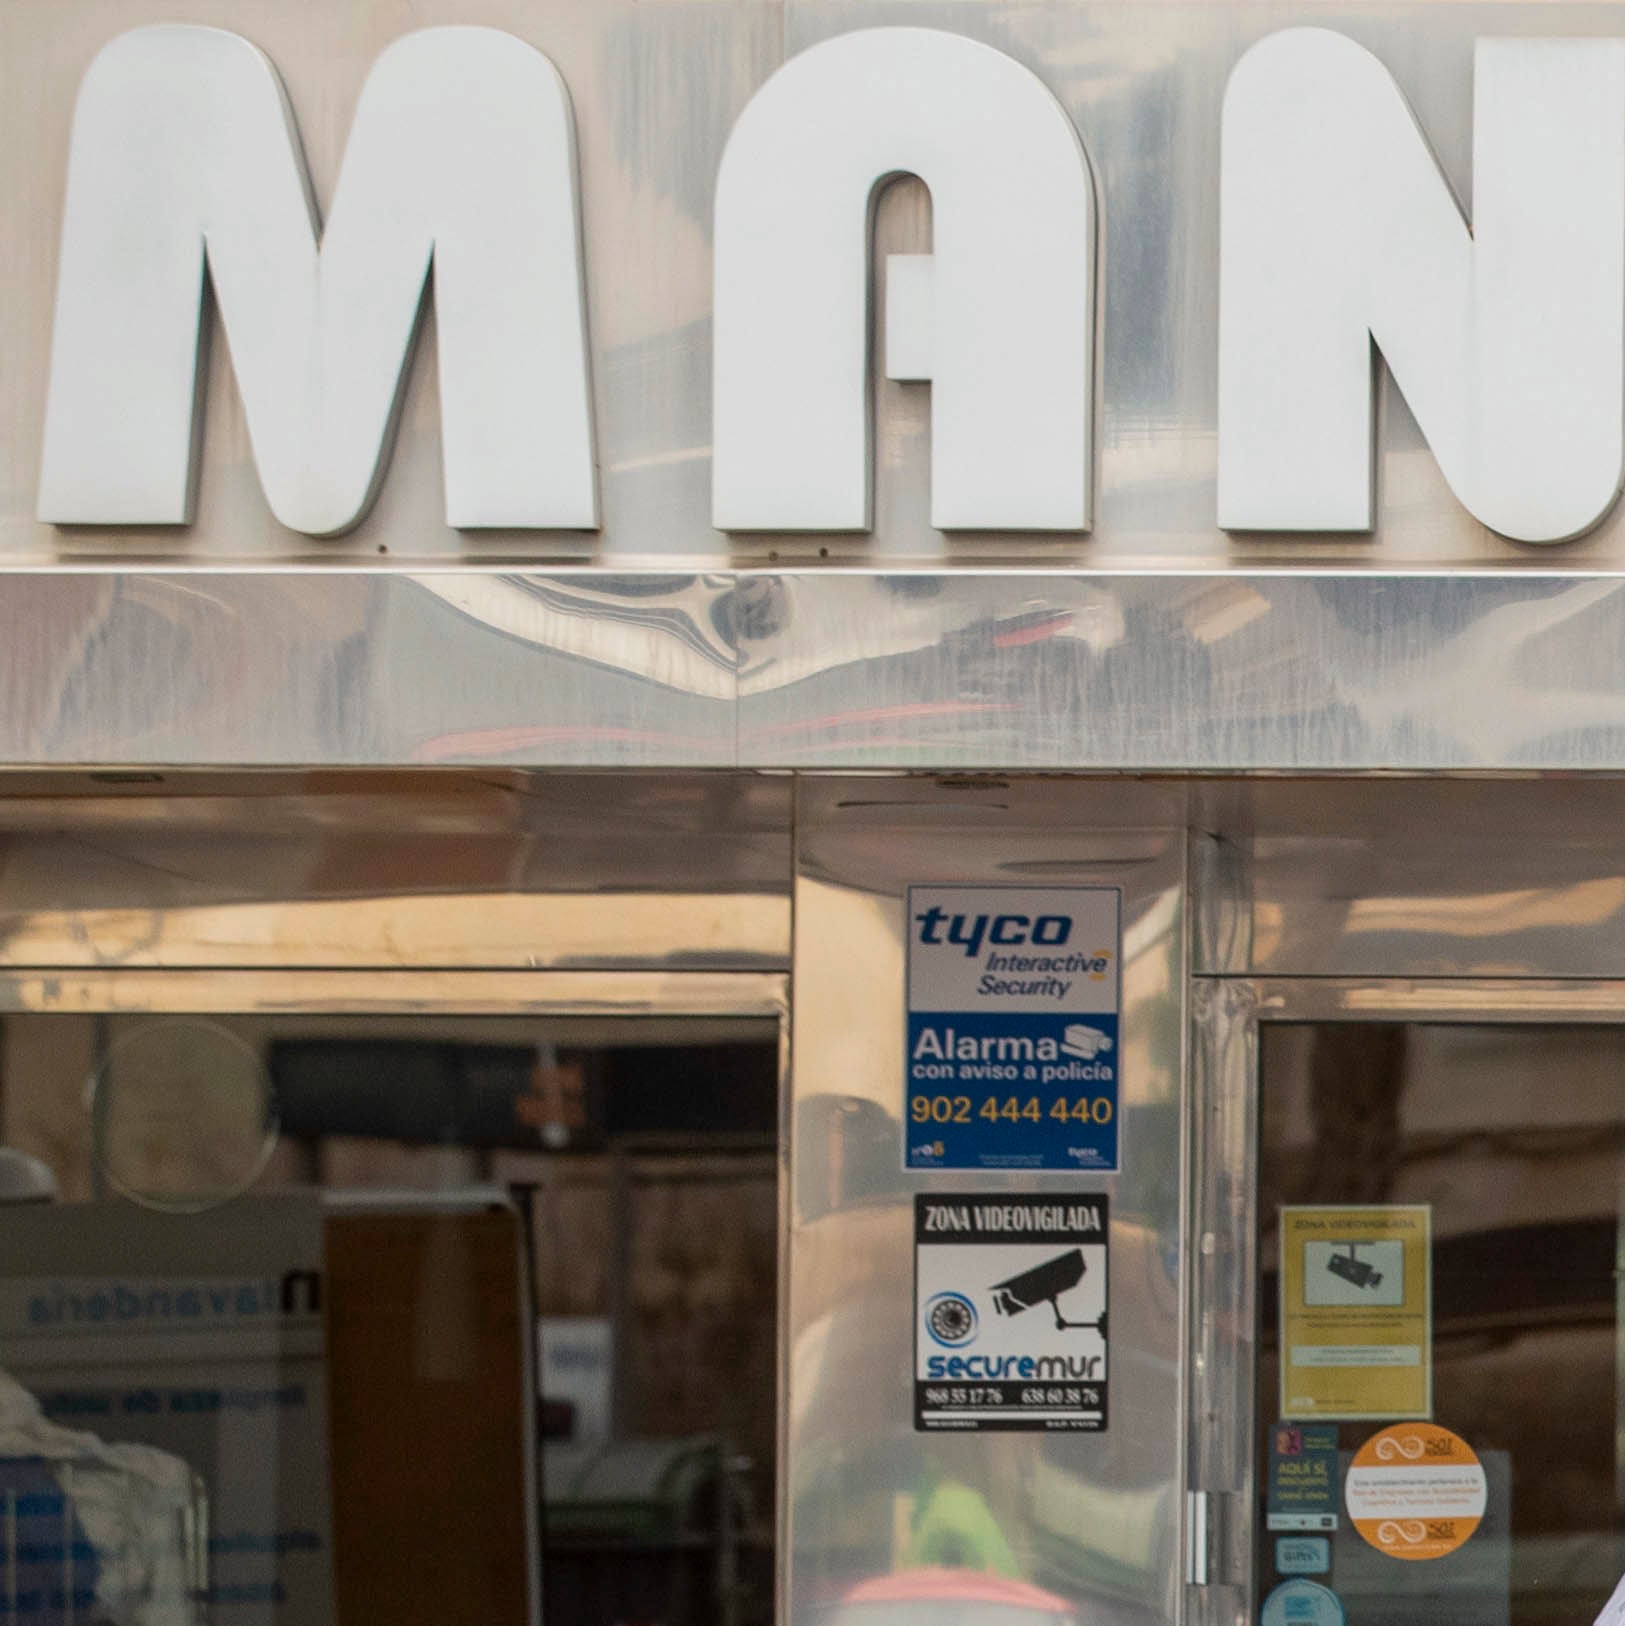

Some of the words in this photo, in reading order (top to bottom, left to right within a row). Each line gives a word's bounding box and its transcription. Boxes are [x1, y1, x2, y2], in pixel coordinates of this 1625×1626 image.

[915, 905, 1073, 957] tyco
[984, 951, 1107, 974] Interactive
[976, 975, 1072, 1000] Security
[912, 1027, 1059, 1062] Alarma
[911, 1063, 955, 1079] con
[958, 1061, 1019, 1081] aviso
[1023, 1065, 1037, 1081] a
[1041, 1061, 1113, 1084] policía
[911, 1095, 972, 1123] 902
[979, 1095, 1041, 1123] 444
[1049, 1096, 1113, 1124] 440
[924, 1205, 972, 1231] ZONA
[973, 1205, 1101, 1231] VIDEOVIGILADA
[927, 1355, 1102, 1379] securemur
